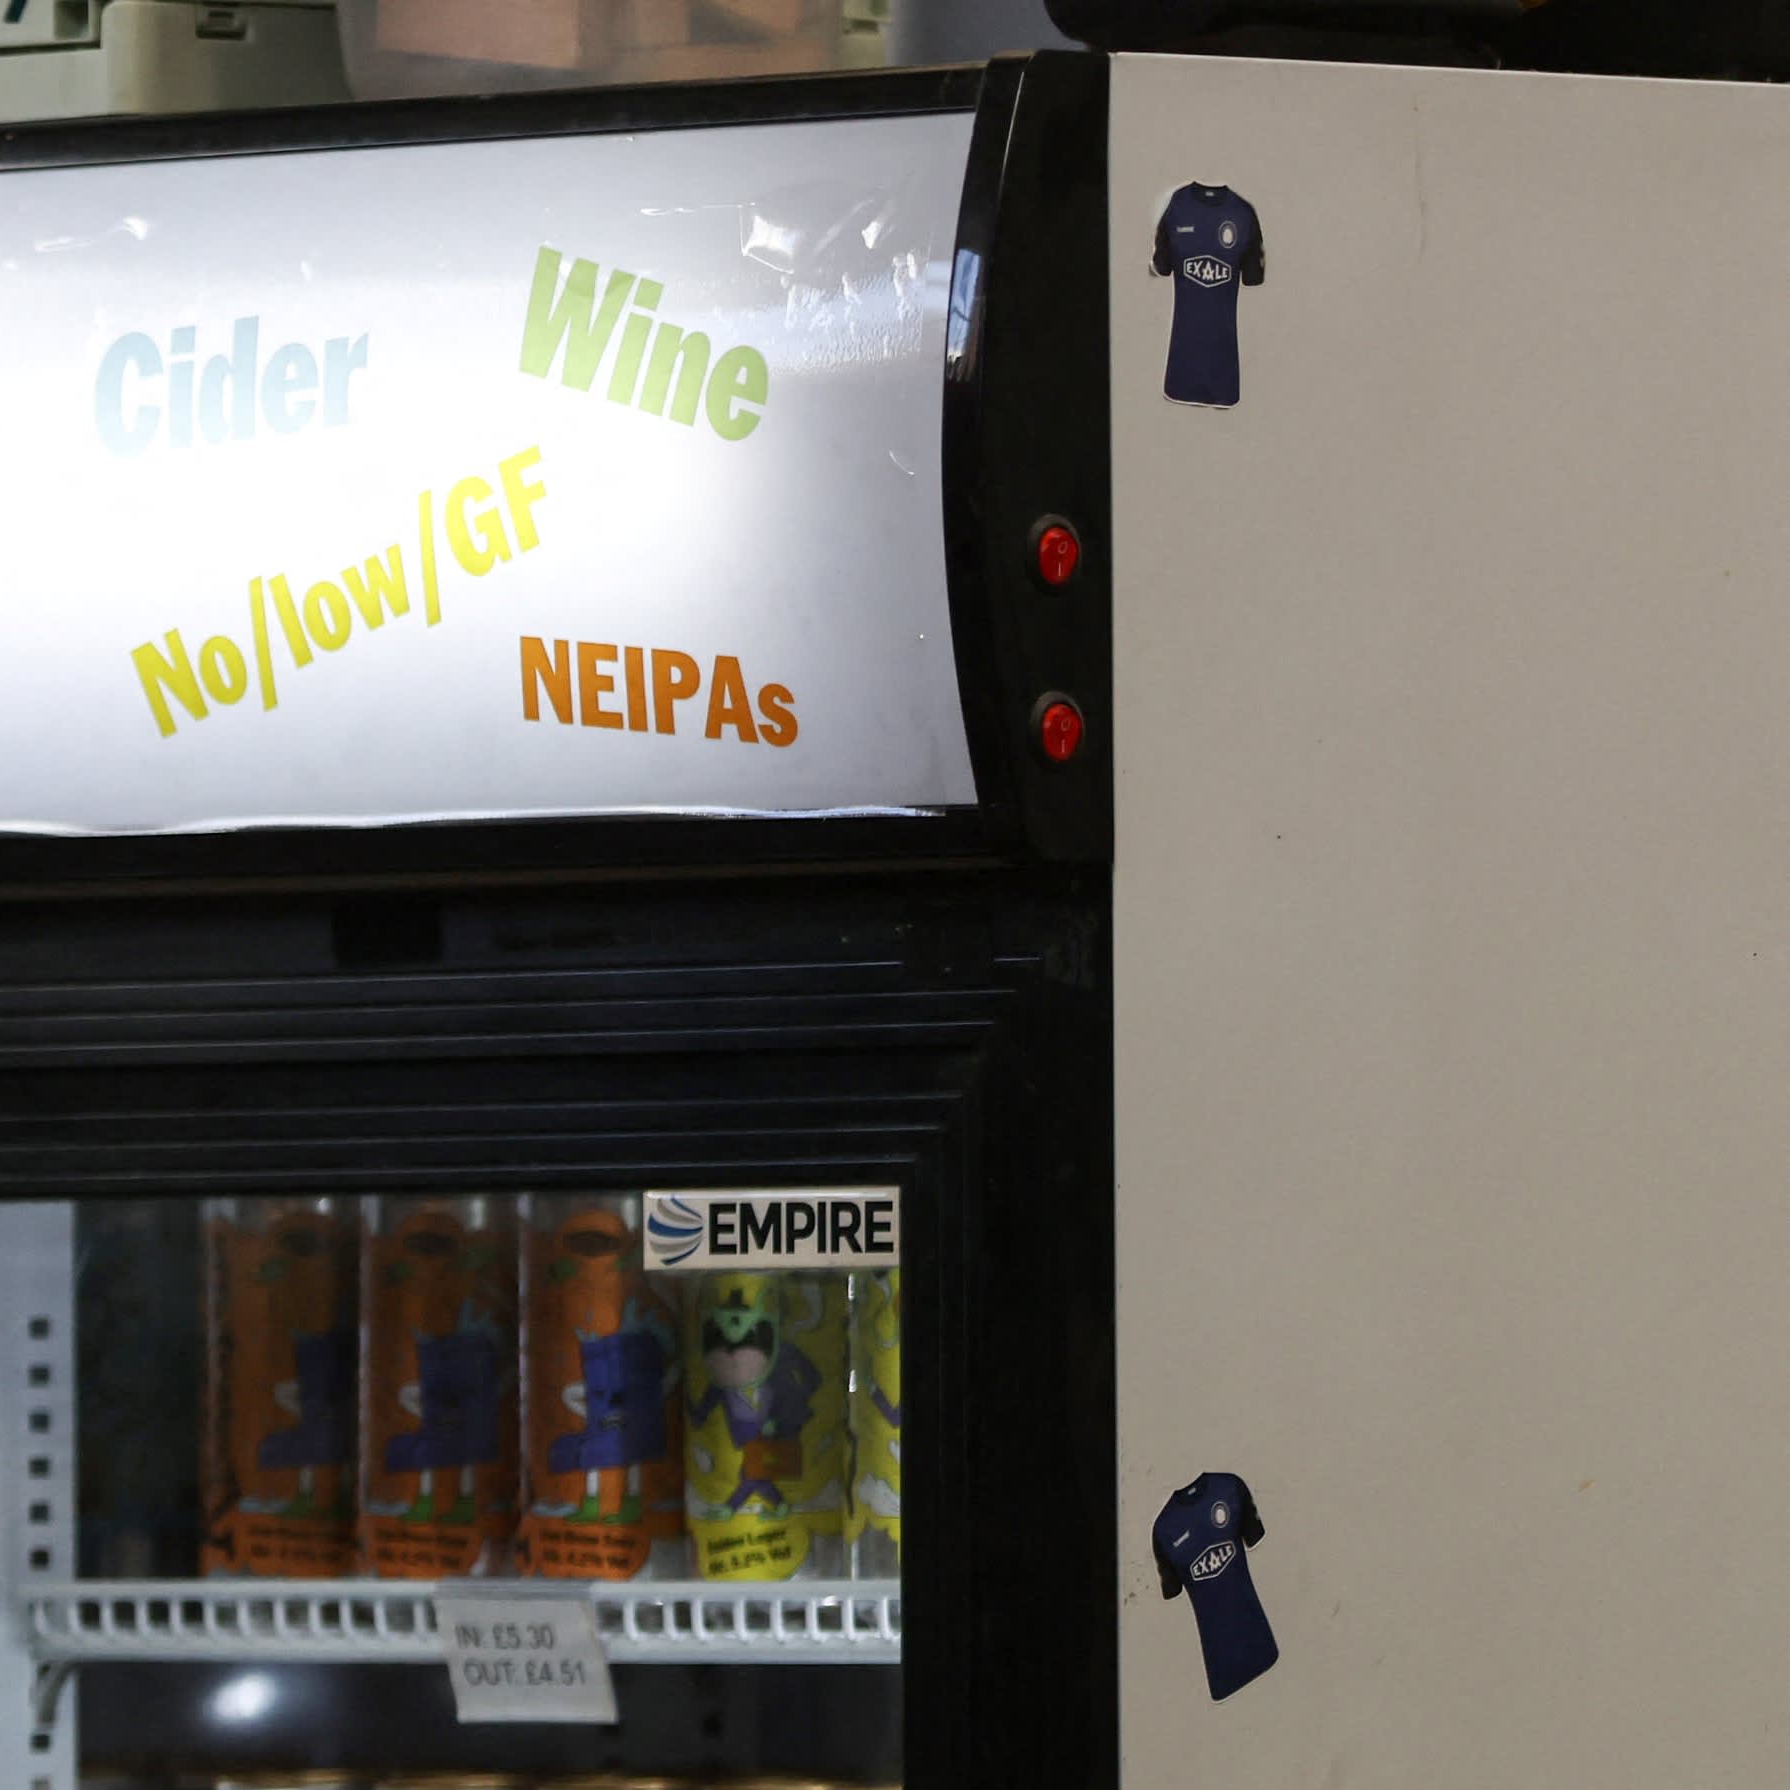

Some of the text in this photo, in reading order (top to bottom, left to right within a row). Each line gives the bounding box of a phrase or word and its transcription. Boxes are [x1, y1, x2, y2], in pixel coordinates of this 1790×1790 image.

[1186, 260, 1228, 281] EXALE
[94, 314, 370, 458] Cider
[518, 245, 770, 442] Wine
[129, 444, 549, 739] No/low/GF
[519, 636, 799, 748] NEIPAs
[709, 1200, 894, 1256] EMPIRE
